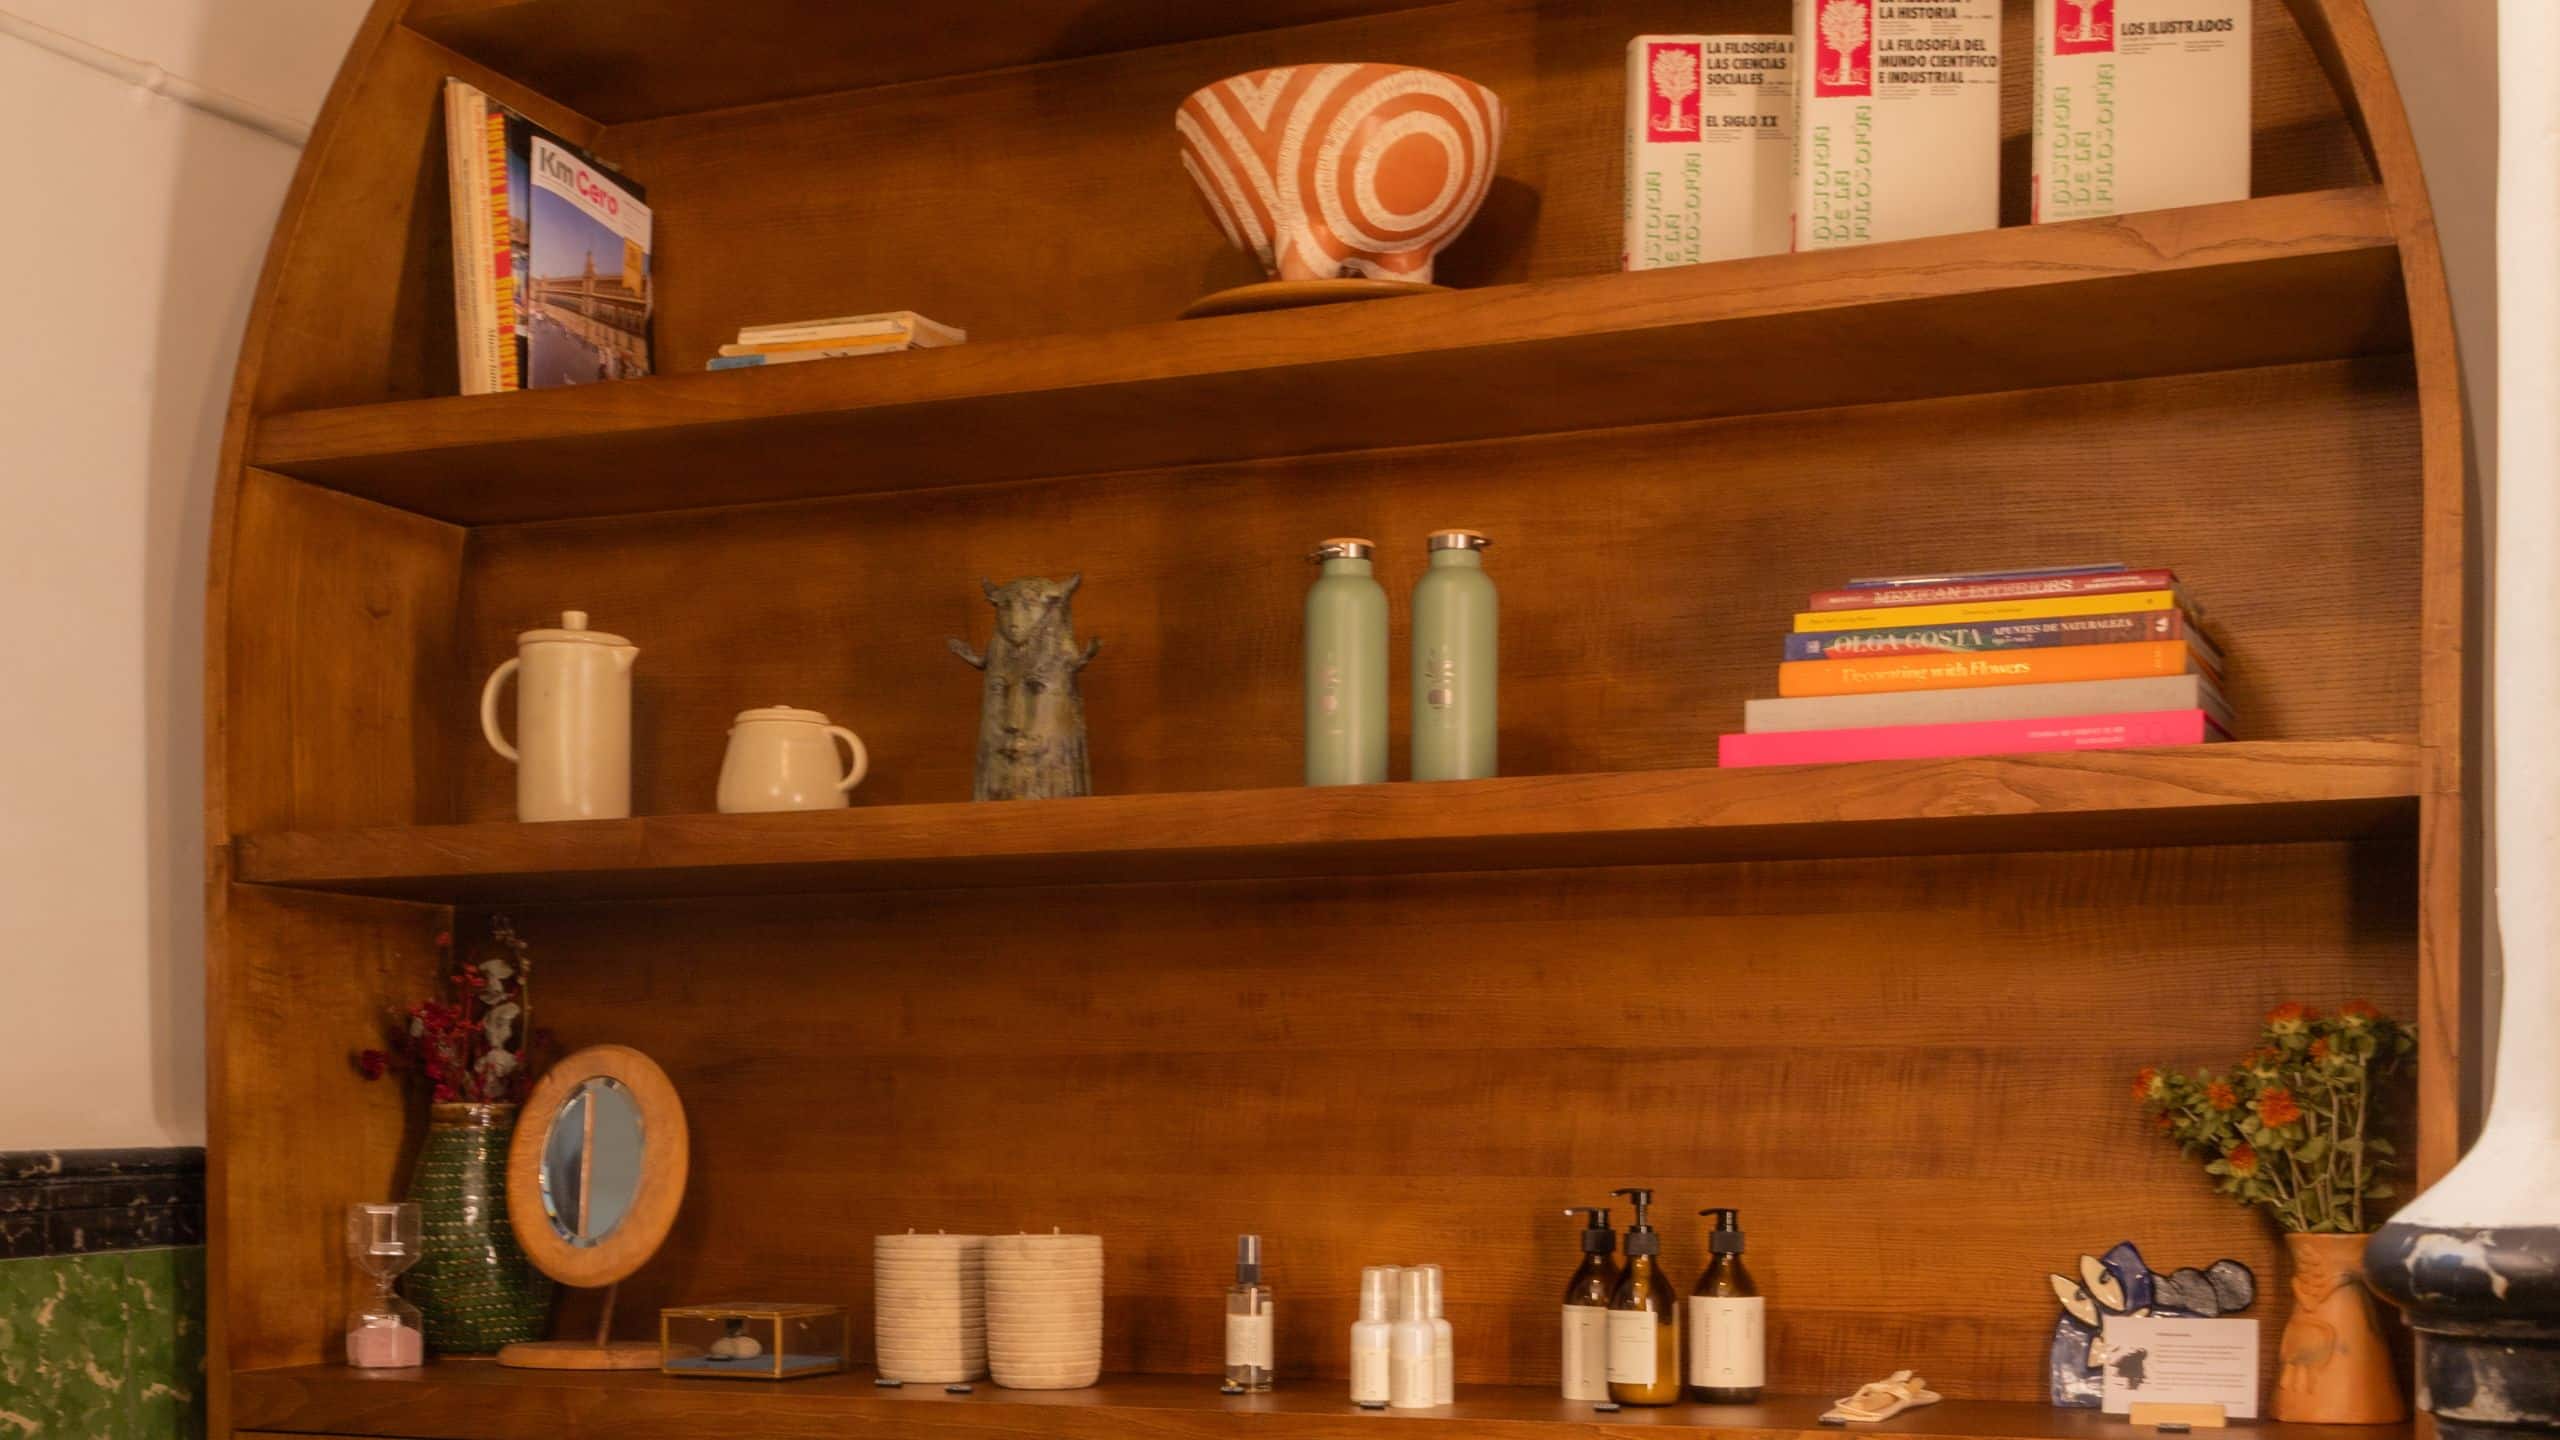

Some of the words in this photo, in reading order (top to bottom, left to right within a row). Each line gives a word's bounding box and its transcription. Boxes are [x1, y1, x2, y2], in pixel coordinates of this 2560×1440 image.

[1879, 7, 1894, 18] LA
[1898, 7, 1957, 18] HISTORIA
[2121, 22, 2144, 36] LOS
[2149, 18, 2233, 34] ILUSTRADOS
[1706, 42, 1722, 53] LA
[1725, 41, 1785, 53] FILOSOFÍA
[1879, 40, 1894, 51] LA
[1898, 37, 1961, 51] FILOSOFÍA
[1964, 40, 1986, 51] DEL
[1707, 58, 1729, 69] LAS
[1733, 58, 1787, 69] CIENCIAS
[1879, 56, 1927, 67] MUNDO
[1930, 54, 1998, 67] CIENTÍFICO
[1706, 73, 1764, 85] SOCIALES
[1879, 72, 1885, 83] E
[1888, 72, 1964, 83] INDUSTRIAL
[1706, 115, 1719, 127] EL
[1722, 115, 1758, 127] SIGLO
[1759, 115, 1778, 127] XX
[1873, 587, 1961, 604] MEXICAN
[1967, 578, 2073, 598] INTERIORS
[1834, 634, 1899, 653] OLGA
[1904, 628, 1983, 649] COSTA
[1992, 624, 2041, 636] APUNTES
[2043, 623, 2058, 632] DE
[2061, 618, 2134, 632] NATURALEZA
[1842, 665, 1928, 682] Decorating
[1930, 662, 1968, 677] with
[1970, 661, 2031, 676] Flowers
